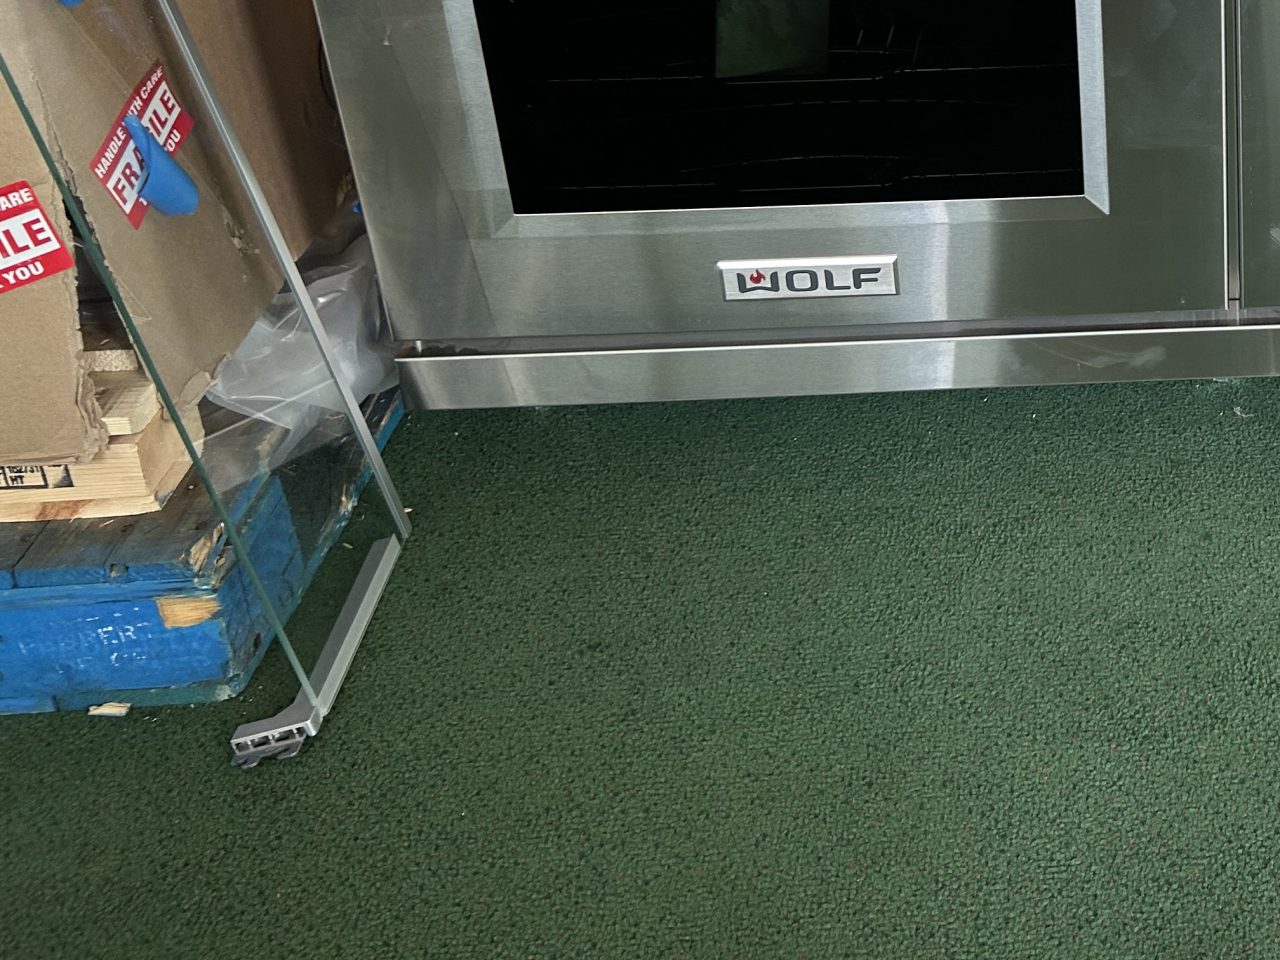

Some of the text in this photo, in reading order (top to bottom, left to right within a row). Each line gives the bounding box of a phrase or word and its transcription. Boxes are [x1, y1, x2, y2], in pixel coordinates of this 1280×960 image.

[94, 125, 127, 179] HANDLE
[140, 65, 164, 99] CARE
[112, 88, 176, 206] FRAILE
[164, 128, 182, 152] OU
[0, 187, 34, 212] ARE
[2, 260, 45, 285] YOU
[737, 267, 882, 294] WOLF
